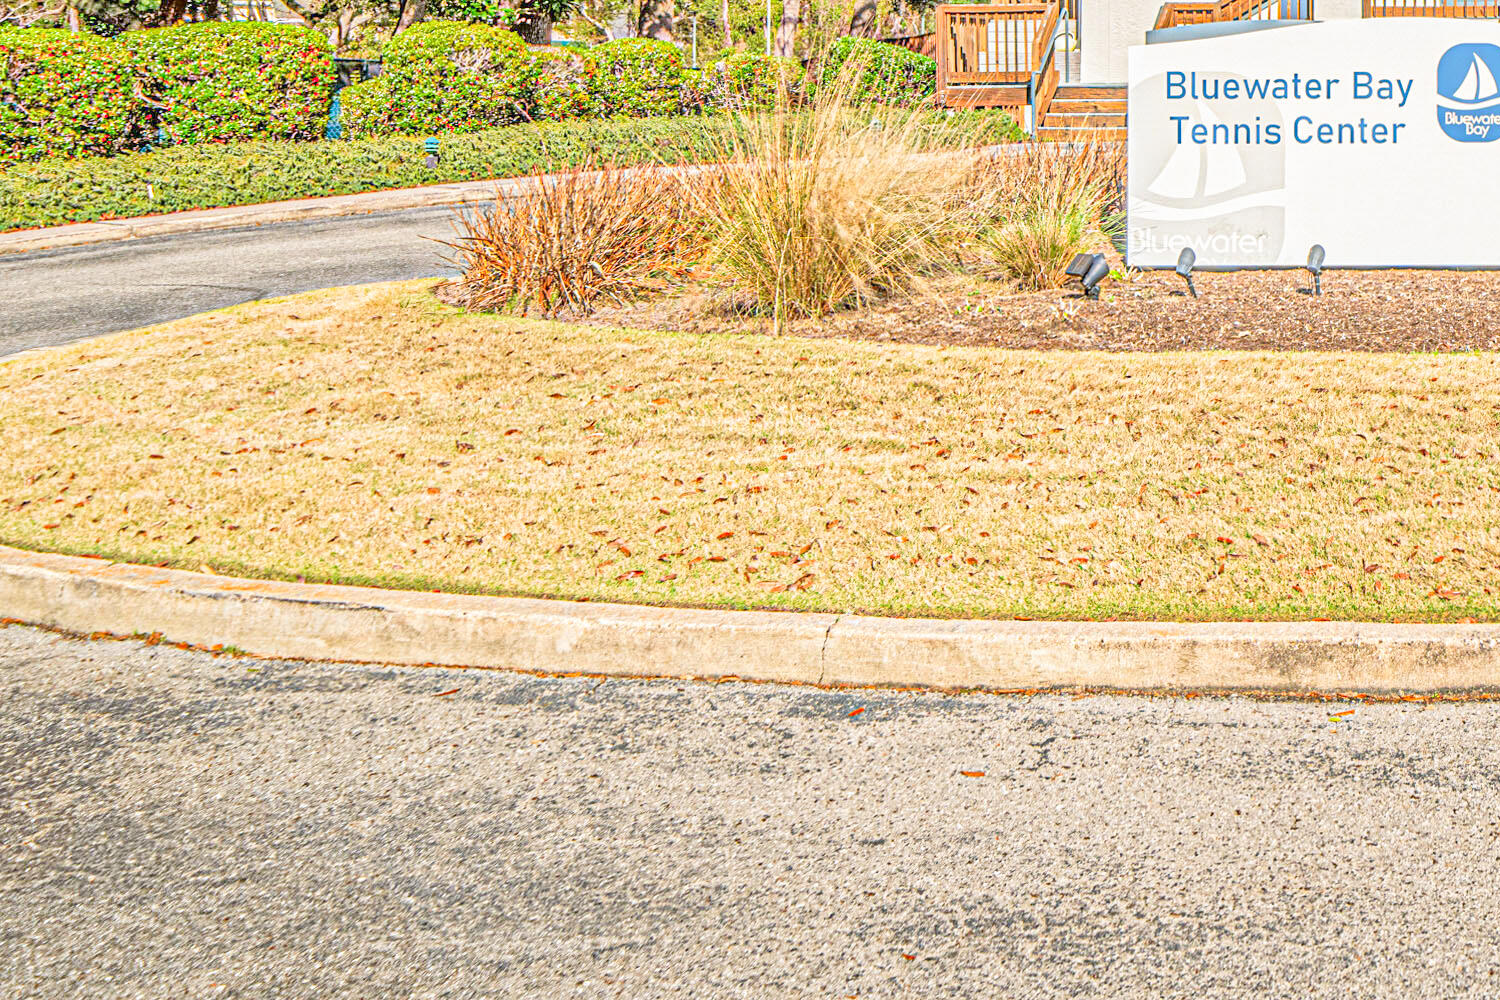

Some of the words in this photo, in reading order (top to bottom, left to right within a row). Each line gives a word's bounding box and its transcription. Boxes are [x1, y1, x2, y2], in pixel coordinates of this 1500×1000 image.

[1166, 71, 1340, 99] Bluewater
[1353, 71, 1414, 107] Bay
[1170, 115, 1281, 145] Tennis
[1293, 115, 1406, 144] Center
[1465, 123, 1490, 138] Bay
[1130, 227, 1270, 254] Bluewater
